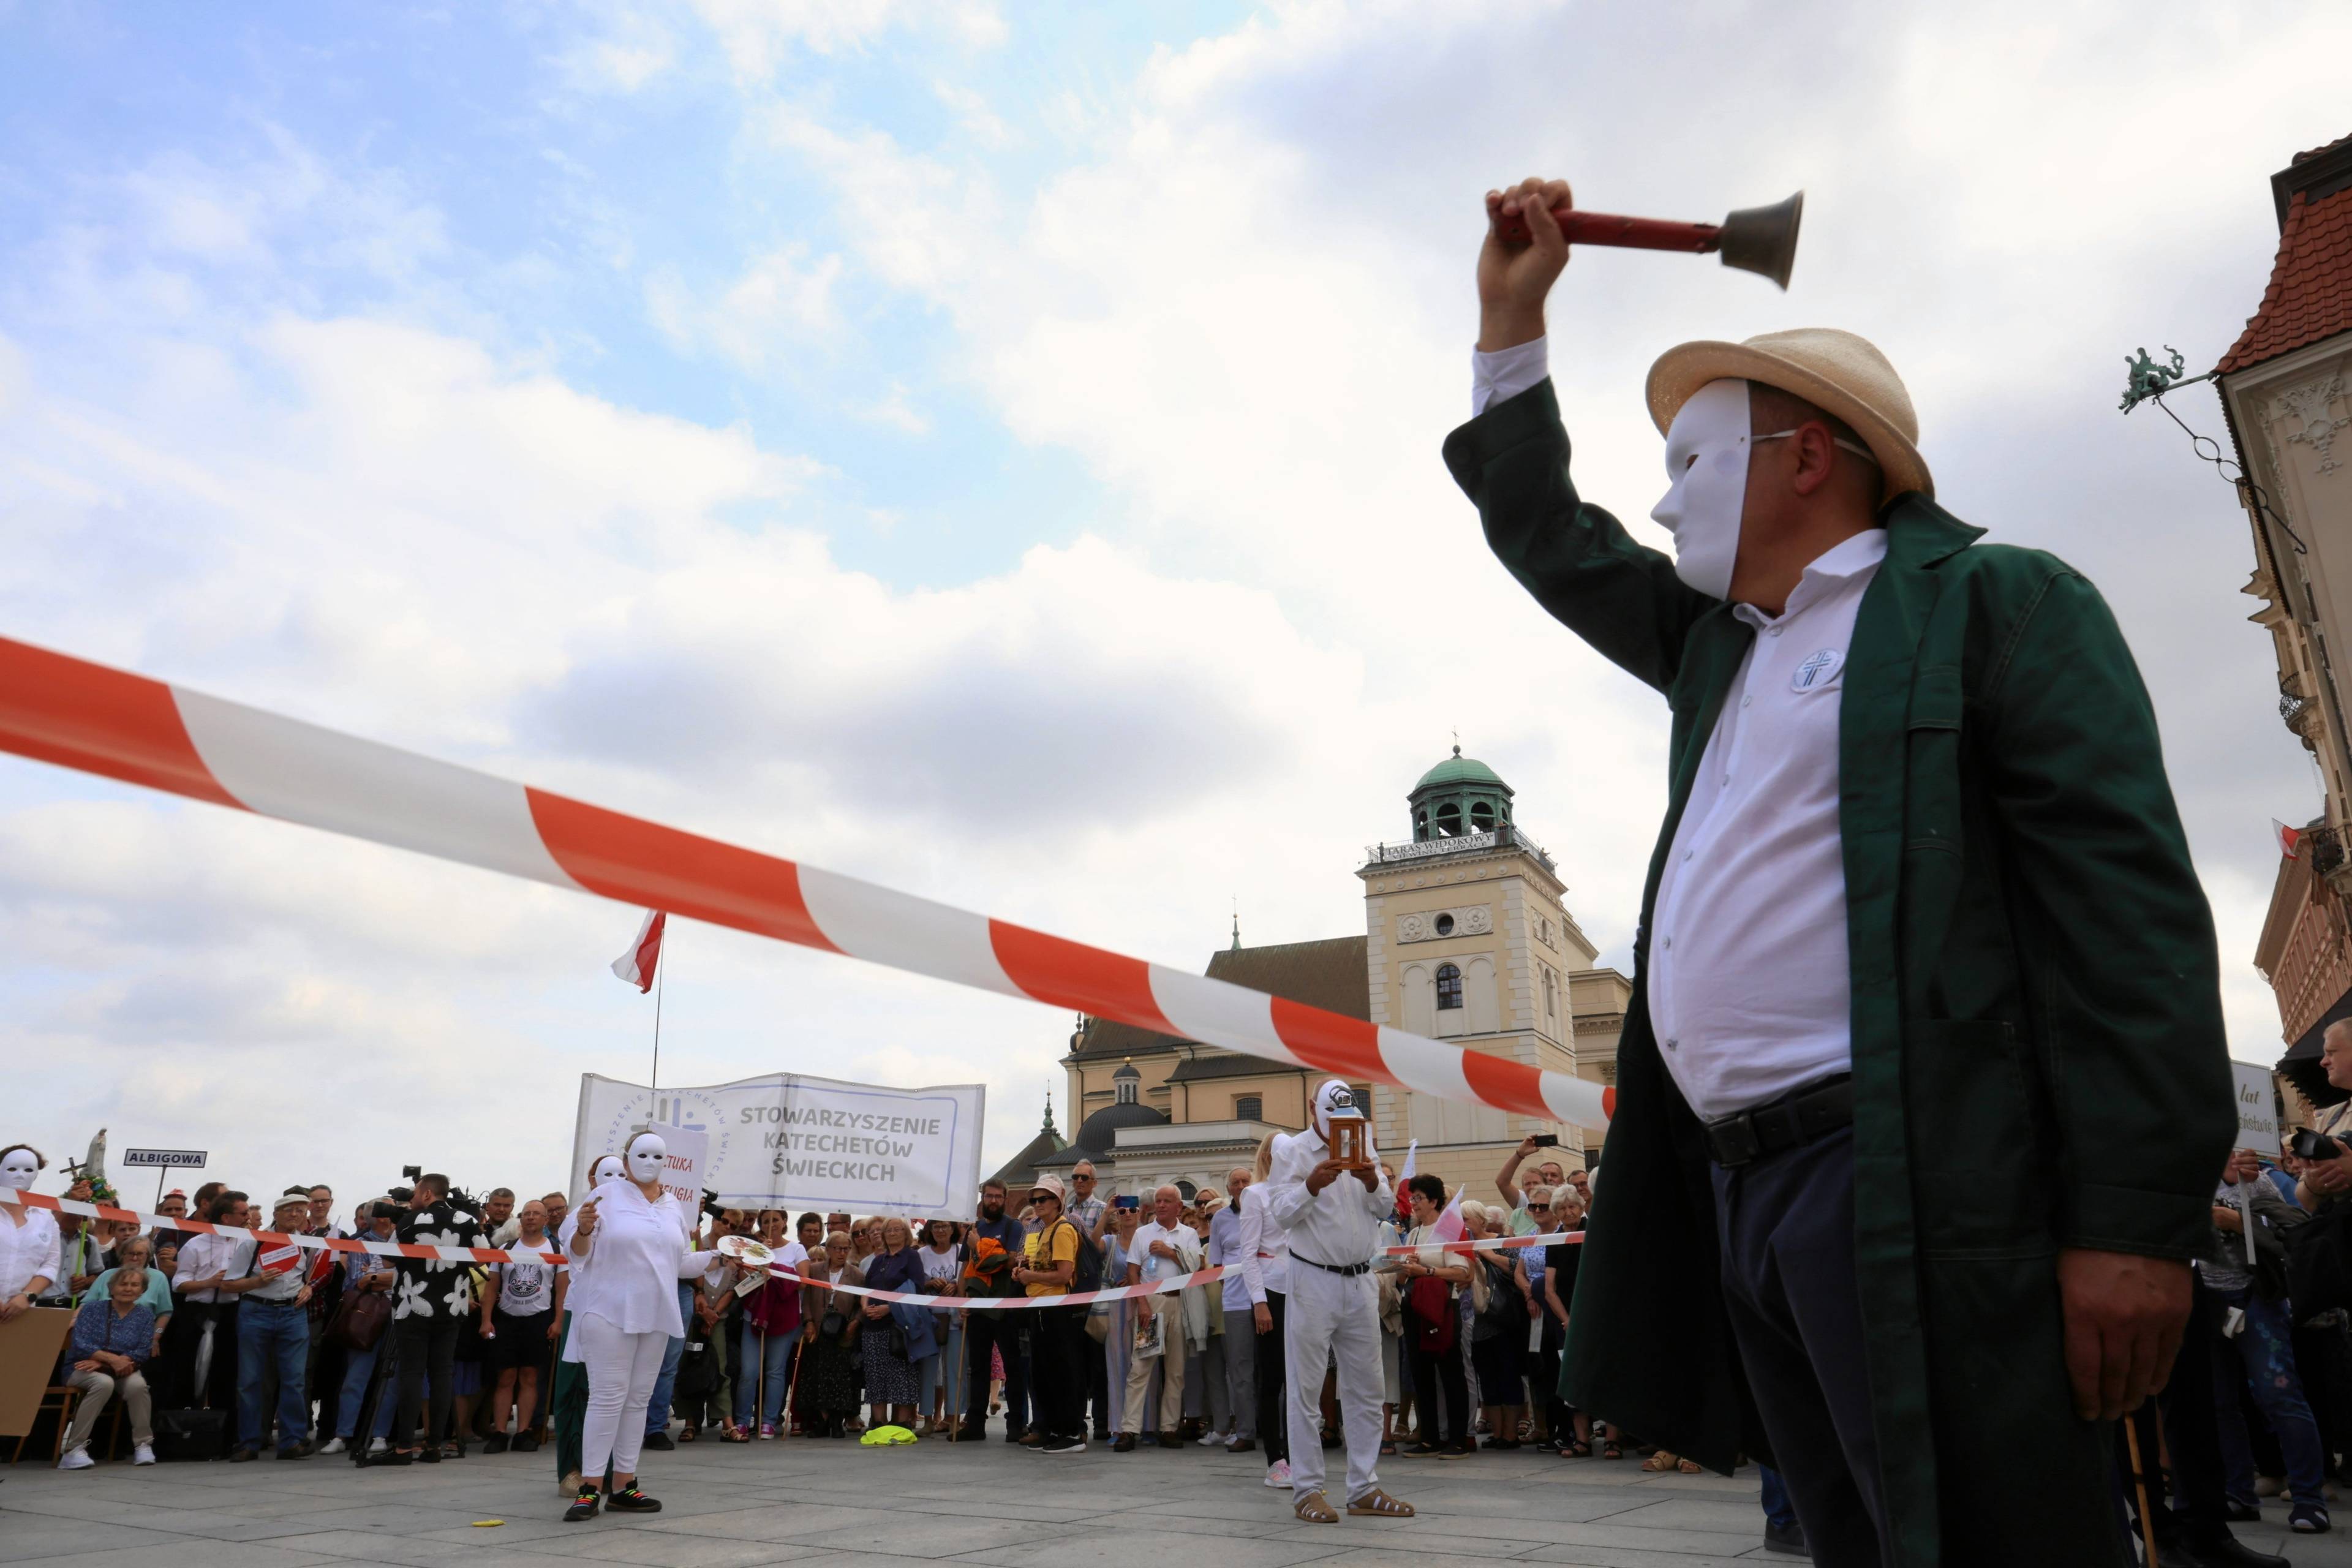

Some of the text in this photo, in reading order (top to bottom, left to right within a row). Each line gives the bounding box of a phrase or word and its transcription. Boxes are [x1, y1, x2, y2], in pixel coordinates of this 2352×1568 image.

[1387, 834, 1493, 856] TARAS WIDOKOWY
[1392, 841, 1487, 859] VIEWING TERRACE
[2240, 1084, 2260, 1104] lat
[740, 1106, 941, 1135] STOWARZYSZENIE
[2239, 1112, 2273, 1134] eństwie
[606, 1094, 644, 1153] ZYSZENIE
[703, 1132, 730, 1185] ŚWIECKI
[764, 1132, 913, 1158] KATECHETÓW
[129, 1153, 202, 1164] ALBIGOWA
[663, 1155, 692, 1172] TUKA
[772, 1152, 895, 1182] ŚWIECKICH
